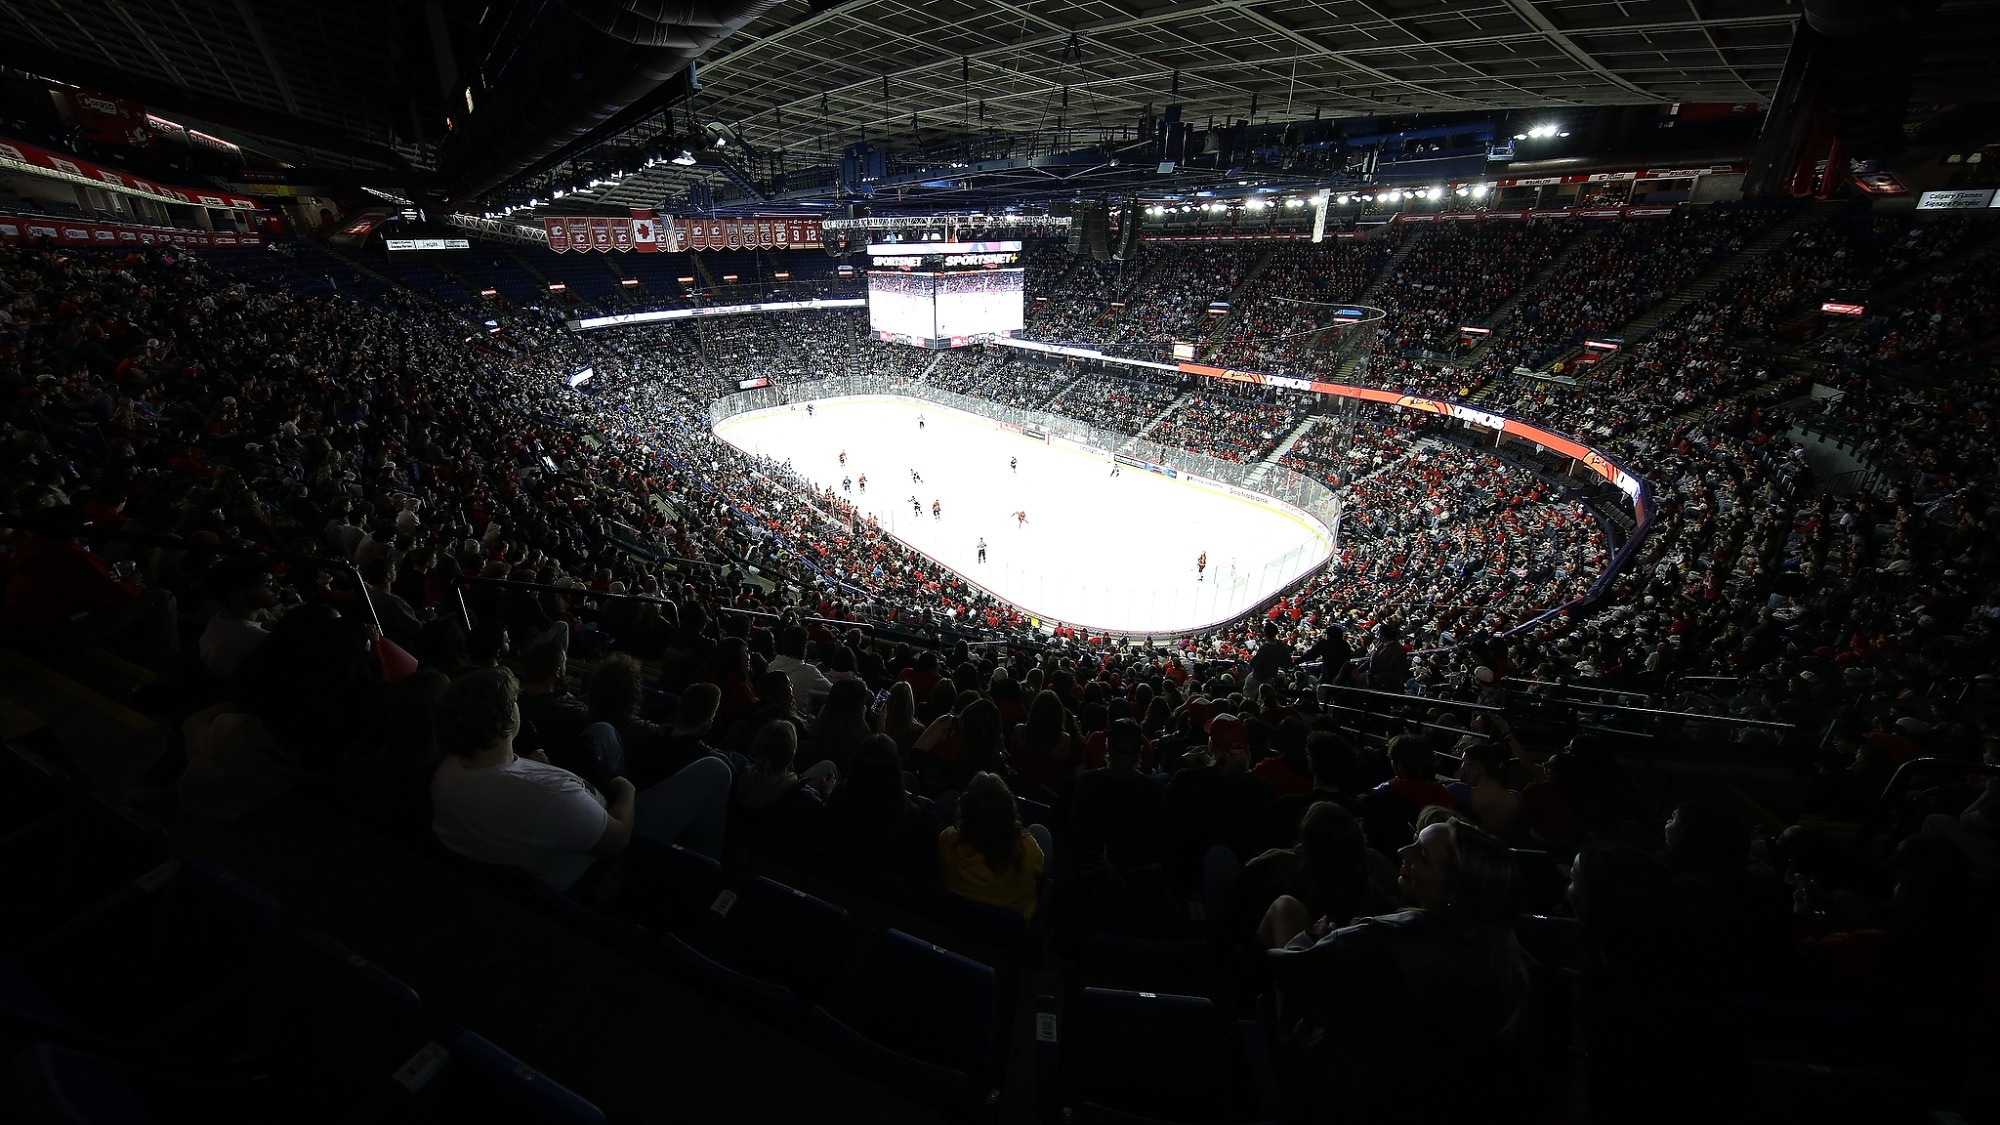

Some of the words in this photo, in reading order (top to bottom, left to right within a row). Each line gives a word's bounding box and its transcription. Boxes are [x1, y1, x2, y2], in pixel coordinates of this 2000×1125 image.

[191, 133, 229, 152] DRINKS
[793, 229, 800, 241] 9
[806, 229, 817, 241] 12
[873, 256, 922, 267] SPORTSNET
